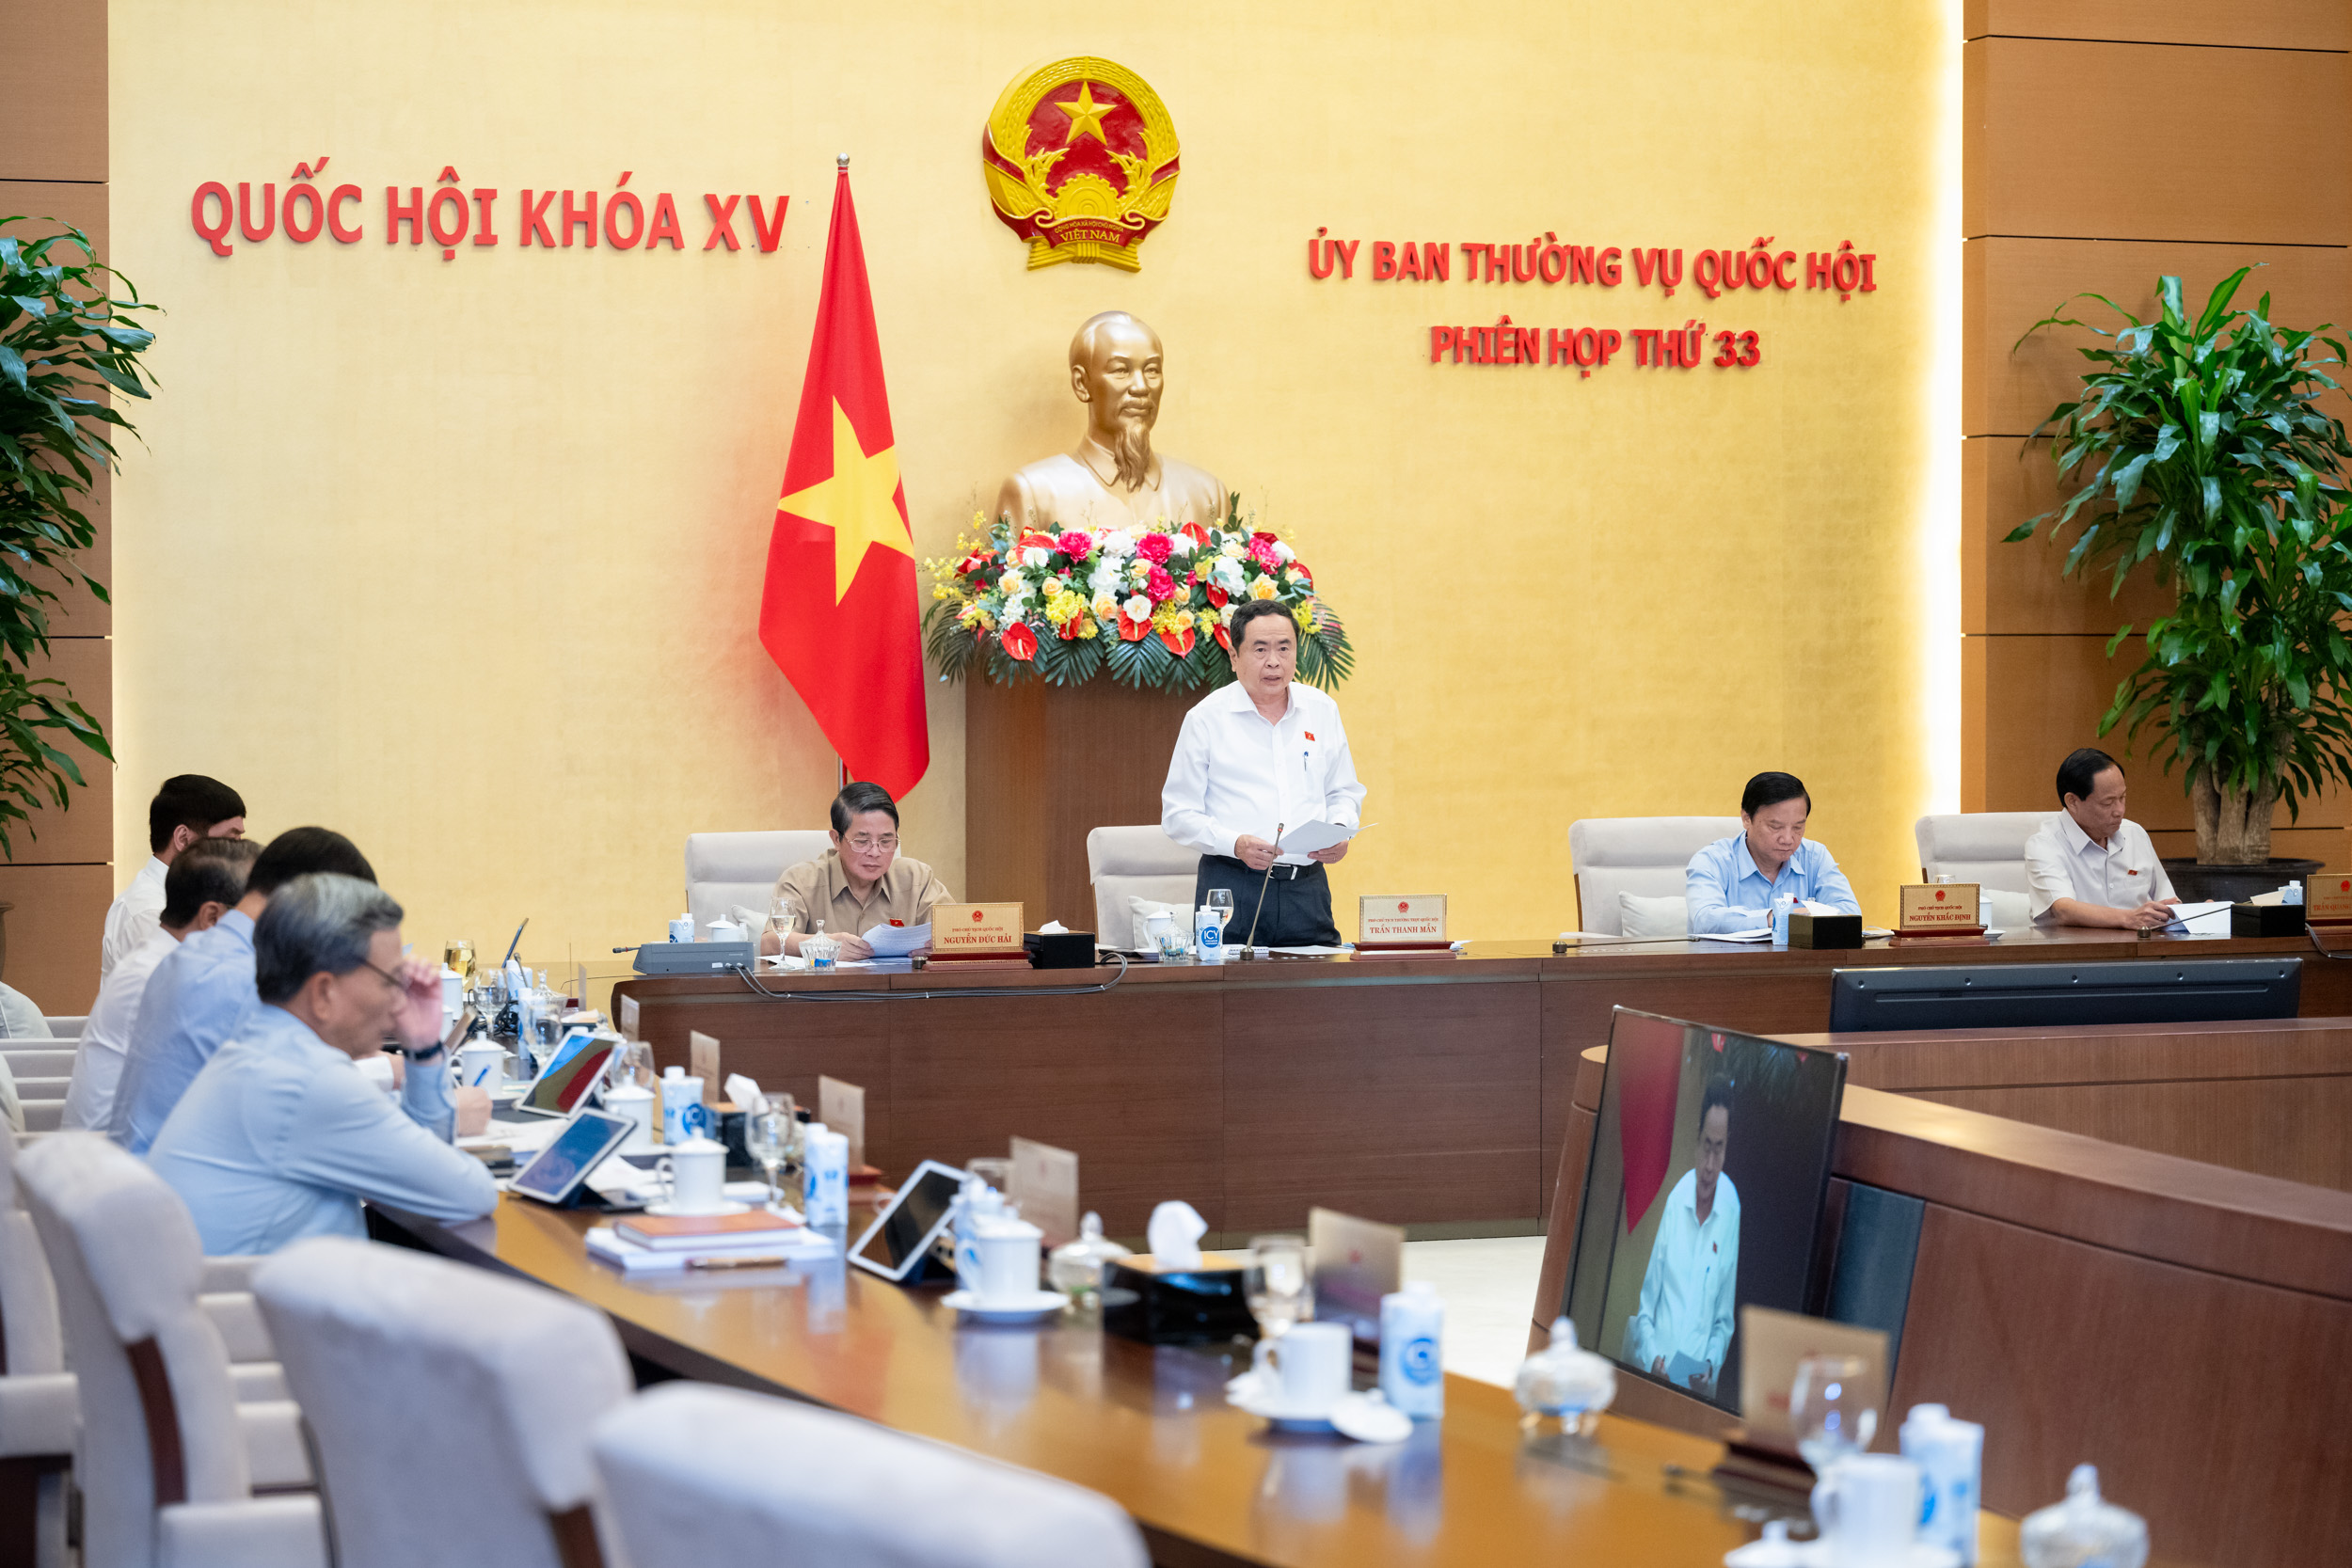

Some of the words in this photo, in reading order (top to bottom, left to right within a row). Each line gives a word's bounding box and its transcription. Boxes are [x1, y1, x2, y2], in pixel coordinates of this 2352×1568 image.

[191, 156, 363, 257] QUỐC
[387, 166, 499, 261] HỘI
[520, 170, 685, 250] KHÓA
[704, 193, 790, 254] XV
[1060, 228, 1089, 242] VIỆT
[1089, 230, 1120, 243] NAM
[1309, 227, 1360, 278] ỦY
[1373, 241, 1450, 281] BAN
[1460, 231, 1622, 287] THƯỜNG
[1631, 247, 1683, 296] VỤ
[1693, 236, 1797, 299] QUỐC
[1805, 240, 1877, 301] HỘI
[1431, 315, 1540, 364] PHIÊN
[1549, 326, 1622, 378] HỌP
[1629, 319, 1707, 369] THỨ
[1713, 330, 1761, 368] 33
[1909, 912, 1935, 921] NGUYỄN
[1936, 912, 1954, 921] KHẮC
[1204, 929, 1219, 940] ICY
[1370, 924, 1391, 934] TRẦN
[1420, 923, 1437, 933] MẪN
[944, 933, 977, 944] NGUYỄN
[978, 934, 996, 943] ĐỨC
[997, 933, 1011, 942] HẢI
